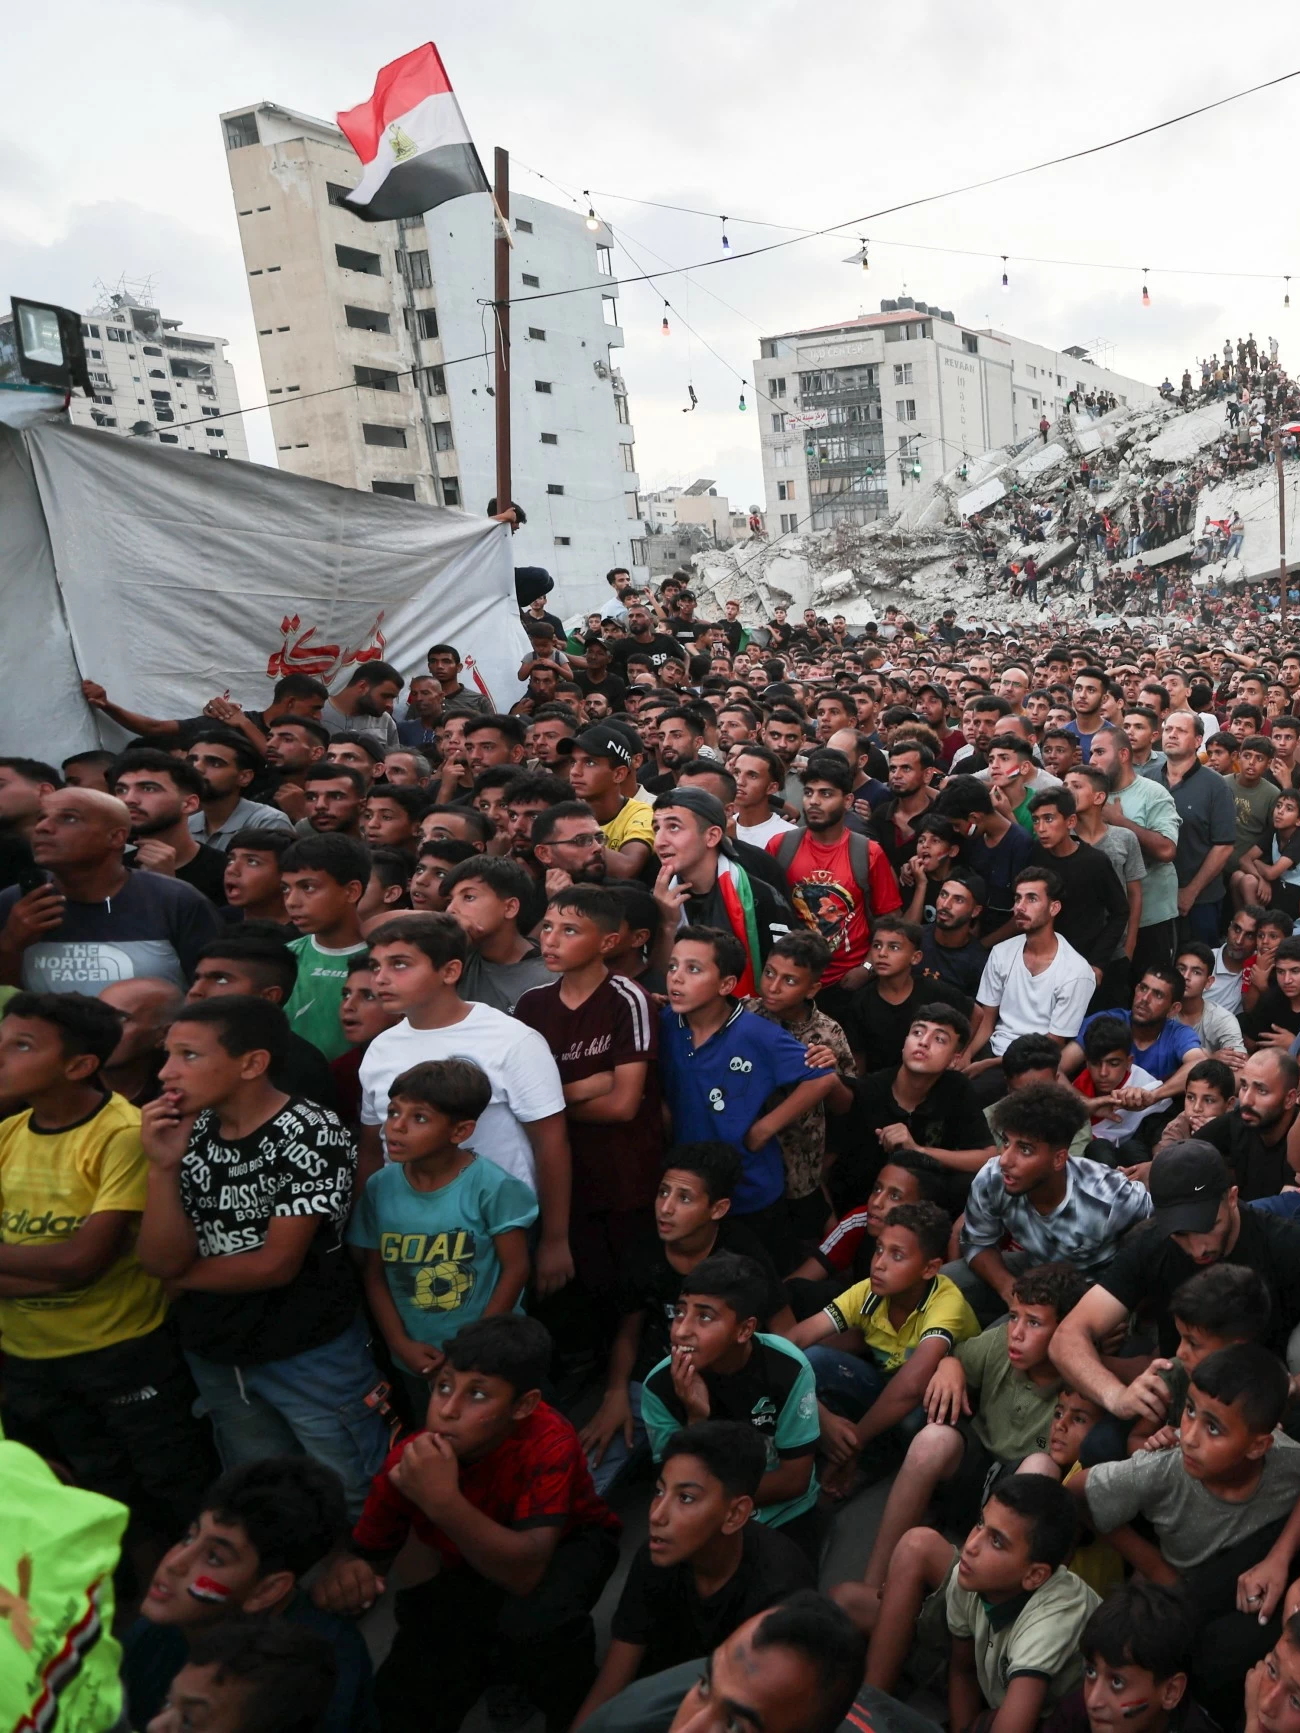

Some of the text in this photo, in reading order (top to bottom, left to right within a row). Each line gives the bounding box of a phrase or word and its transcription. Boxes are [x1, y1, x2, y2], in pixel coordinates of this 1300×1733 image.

[62, 944, 100, 957] THE
[34, 956, 100, 969] NORTH
[50, 969, 100, 981] FACE
[310, 967, 349, 978] Zeus
[561, 1034, 612, 1061] wild child
[228, 1162, 248, 1178] HUGO
[291, 1177, 334, 1194] BOSS
[219, 1183, 258, 1211] BOSS
[235, 1204, 271, 1222] BOSS
[380, 1231, 474, 1263] GOAL
